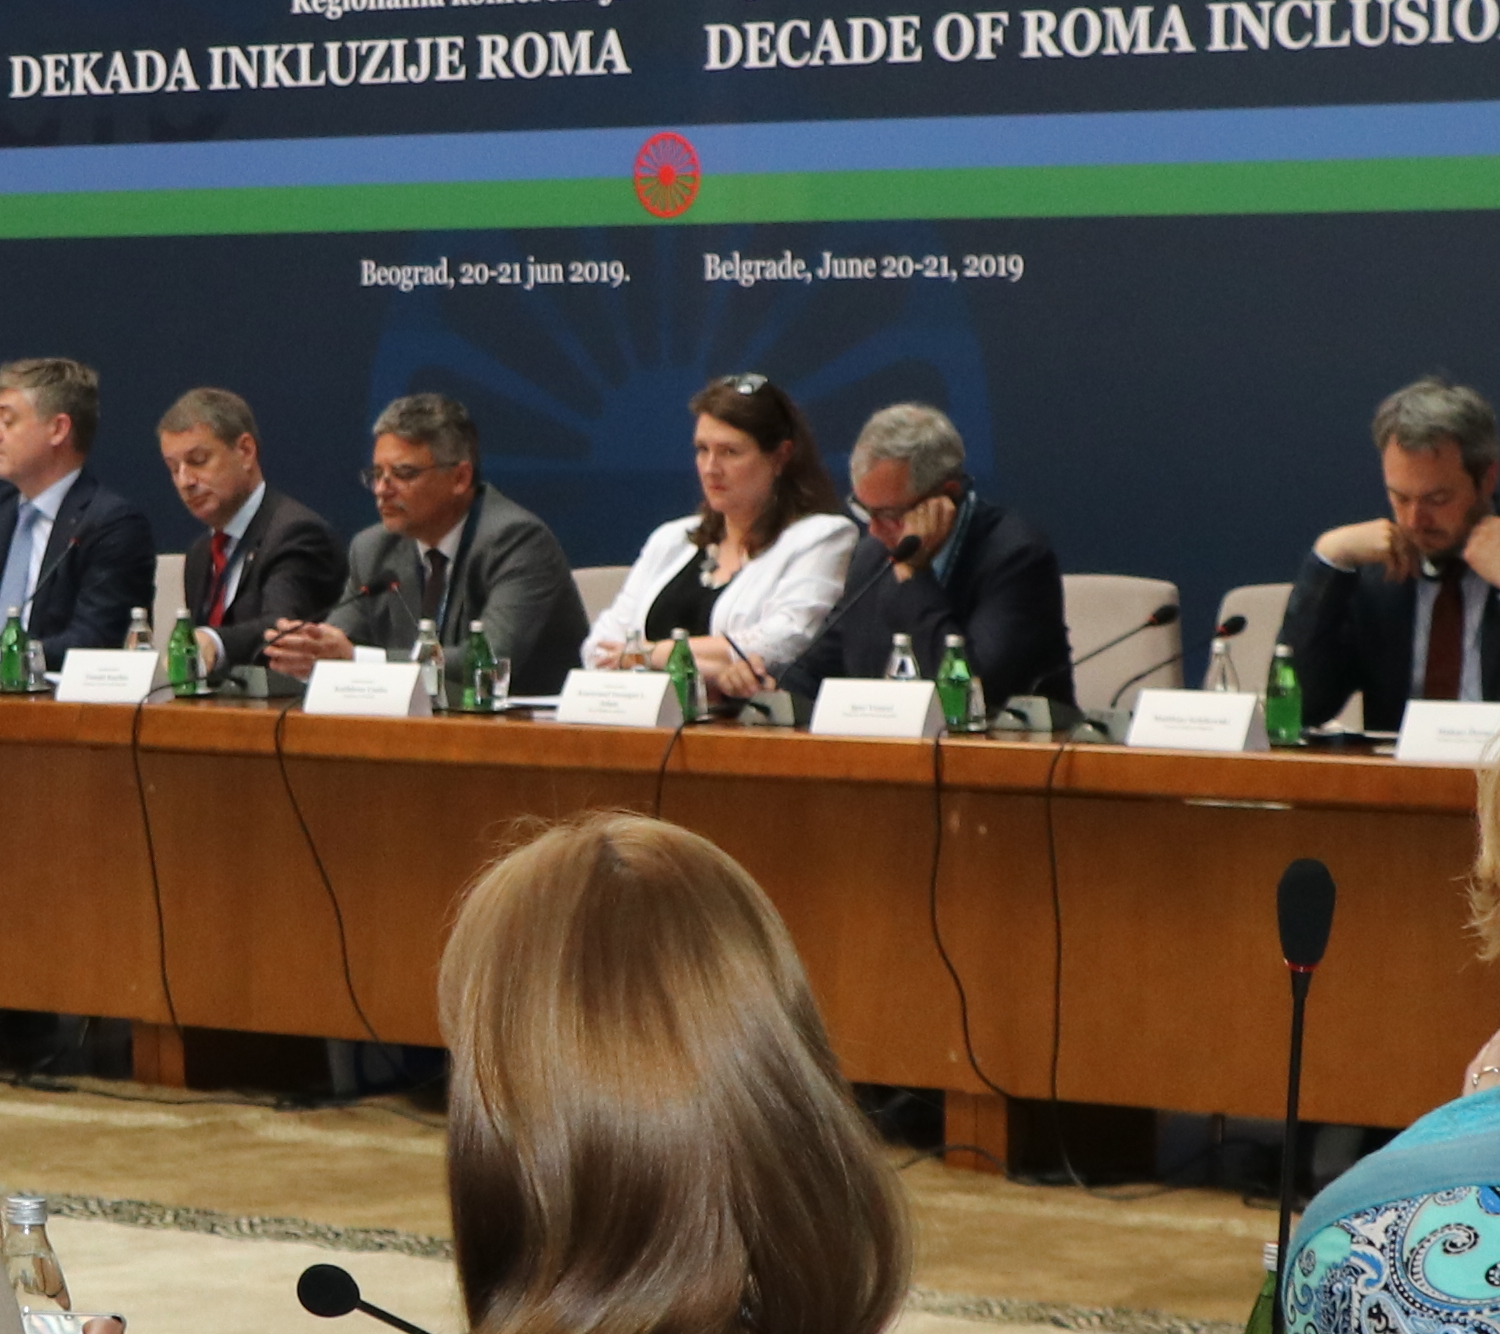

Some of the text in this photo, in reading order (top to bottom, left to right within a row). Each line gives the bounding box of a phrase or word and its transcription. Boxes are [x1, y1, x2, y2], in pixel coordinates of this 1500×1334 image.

[704, 15, 921, 71] DECADE
[933, 12, 1010, 63] OF
[1021, 4, 1196, 59] ROMA
[9, 28, 632, 98] DEKADA INKLUZIJE ROMA
[360, 259, 631, 291] Beograd, 20-21 jun 2019.
[704, 252, 1024, 284] Belgrade, June 20-21, 2019
